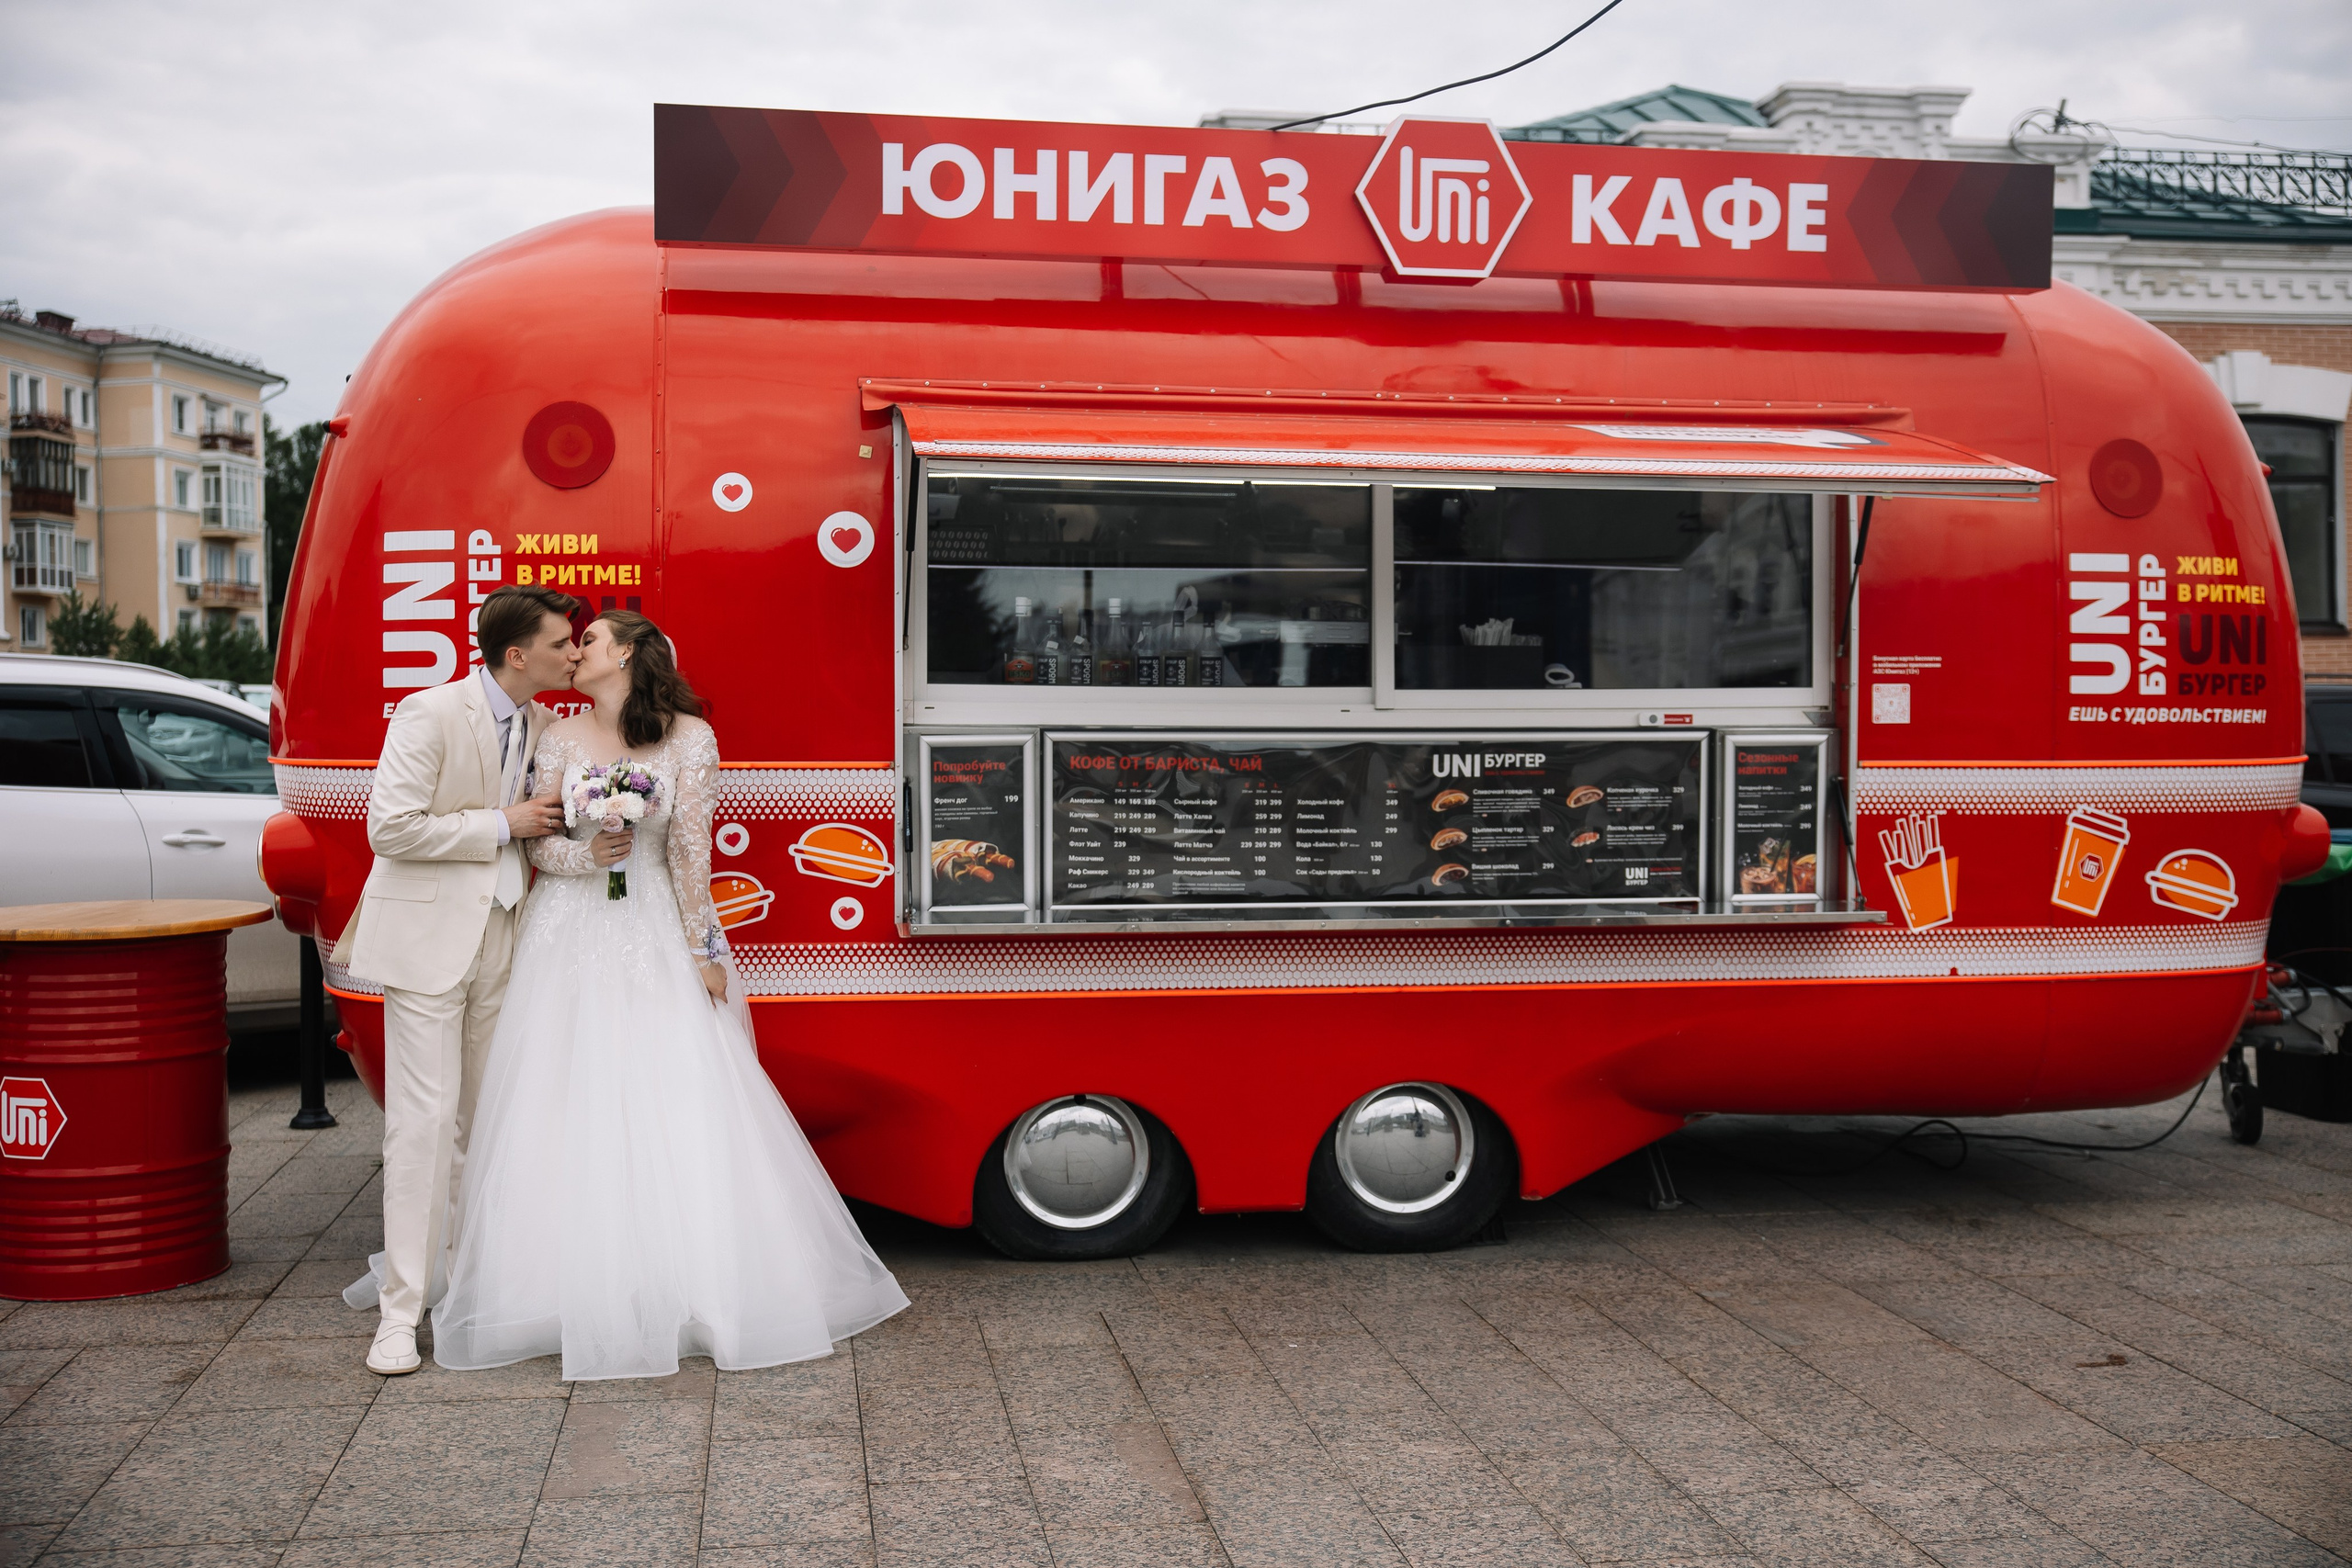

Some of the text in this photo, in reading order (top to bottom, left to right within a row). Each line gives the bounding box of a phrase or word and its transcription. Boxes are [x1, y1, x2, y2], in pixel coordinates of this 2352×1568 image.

[882, 142, 1310, 231] ЮНИГАЗ
[1571, 174, 1828, 253] КАФЕ
[514, 534, 599, 555] ЖИВИ
[516, 564, 641, 585] В РИТМЕ!
[2176, 556, 2239, 577] ЖИВИ
[2177, 582, 2267, 605] В РИТМЕ!
[381, 529, 458, 688] UNI
[2069, 552, 2132, 694] UNI
[2138, 553, 2167, 695] БУРГЕР
[2178, 614, 2267, 666] UNI
[2178, 673, 2267, 696] БУРГЕР
[2069, 705, 2267, 726] ЕШЬ С УДОВОЛЬСТВИЕМ!
[933, 760, 1006, 773] Попробуйте
[1069, 754, 1262, 773] КОФЕ ОТ БАРИСТА, ЧАЙ
[1433, 754, 1480, 777] UNI
[1485, 753, 1546, 768] БУРГЕР
[1737, 751, 1799, 762] Сезонные
[933, 773, 983, 784] новинку
[1737, 766, 1788, 774] напитки
[1004, 795, 1019, 803] 199
[1069, 811, 1100, 819] Капучино
[1625, 867, 1648, 879] UNI
